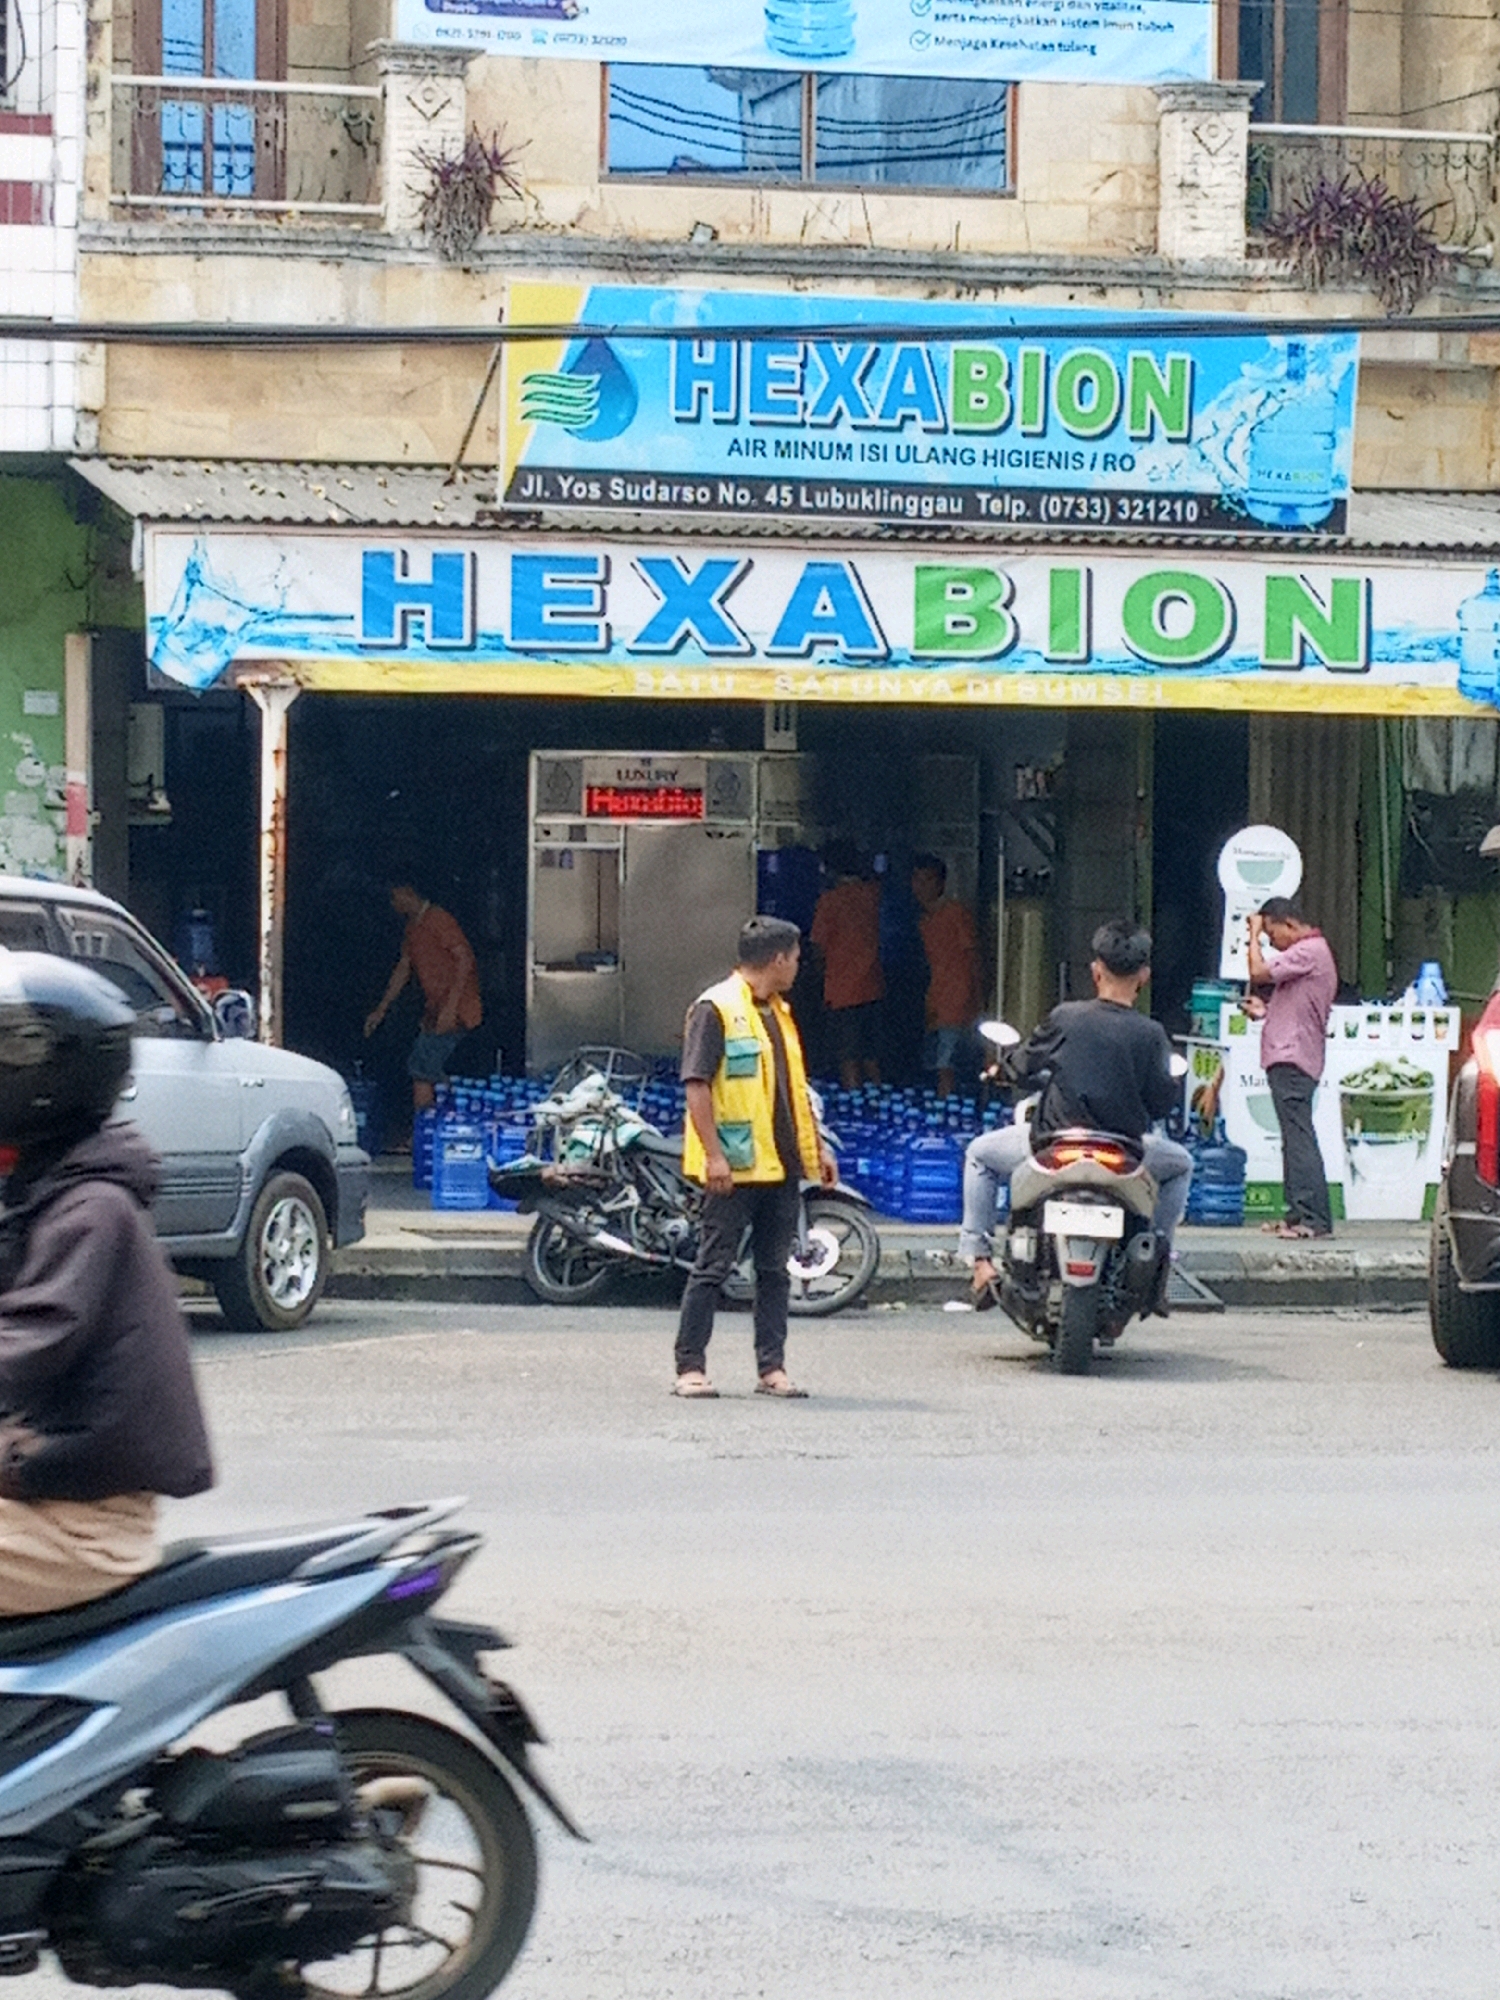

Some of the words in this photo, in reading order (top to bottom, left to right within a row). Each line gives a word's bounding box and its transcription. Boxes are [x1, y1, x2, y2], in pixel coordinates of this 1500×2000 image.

[669, 338, 1195, 444] HEXABION
[727, 437, 767, 458] AIR
[774, 439, 853, 462] MINUM
[860, 442, 888, 463] ISI
[896, 445, 976, 467] ULANG
[982, 448, 1085, 471] HIGIENIS
[1103, 453, 1136, 473] RO
[520, 475, 549, 498] Jl.
[557, 475, 601, 501] Yos
[609, 477, 709, 505] Sudarso
[718, 482, 757, 506] No.
[765, 485, 792, 508] 45
[800, 486, 963, 518] Lubuklinggau
[976, 492, 1031, 523] Telp.
[1039, 494, 1111, 524] (0733)
[1117, 498, 1198, 522] 321210
[358, 546, 1371, 674] HEXABION
[635, 671, 735, 694] SATU
[774, 674, 953, 698] SATUNYA
[966, 678, 1004, 699] DI
[1017, 679, 1173, 706] SUMSEL
[616, 768, 680, 782] LUXURY
